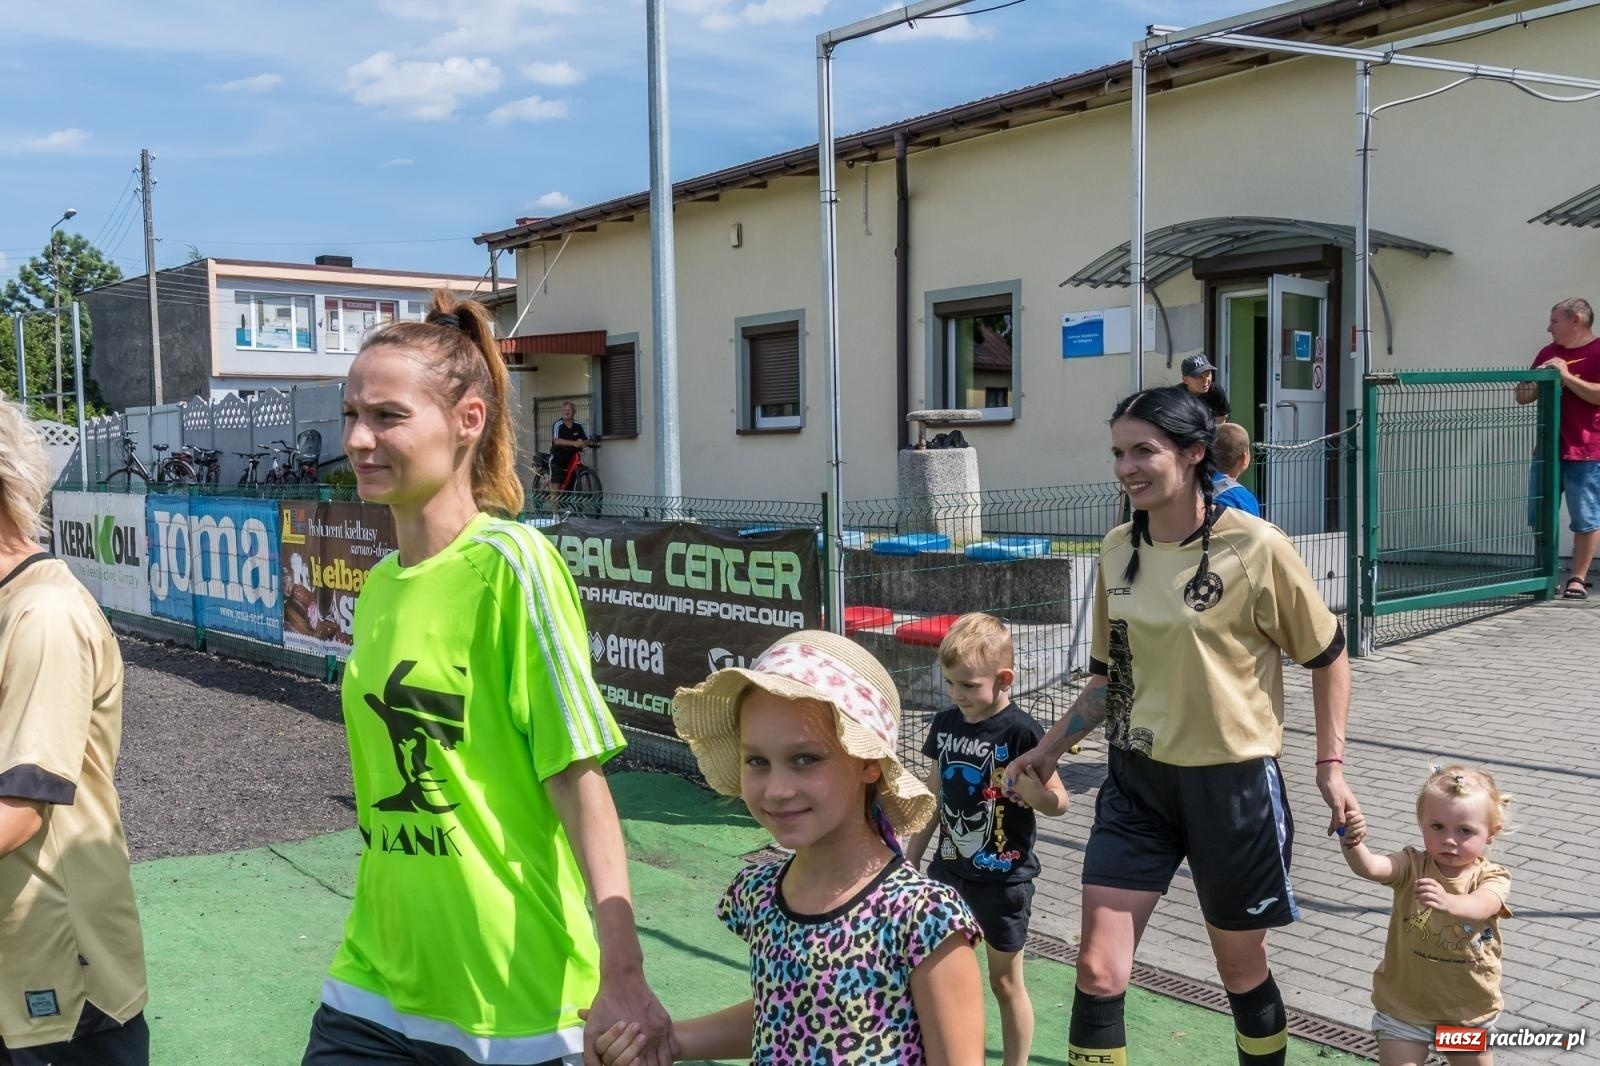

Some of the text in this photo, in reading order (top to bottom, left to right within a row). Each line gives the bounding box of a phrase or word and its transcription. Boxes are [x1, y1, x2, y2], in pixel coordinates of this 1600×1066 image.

[59, 514, 140, 567] KERAKOLL
[546, 535, 802, 600] BALL CENTER
[602, 588, 694, 615] HURTOWNIA
[696, 600, 804, 629] SPORTOWA
[937, 732, 990, 758] SAVING
